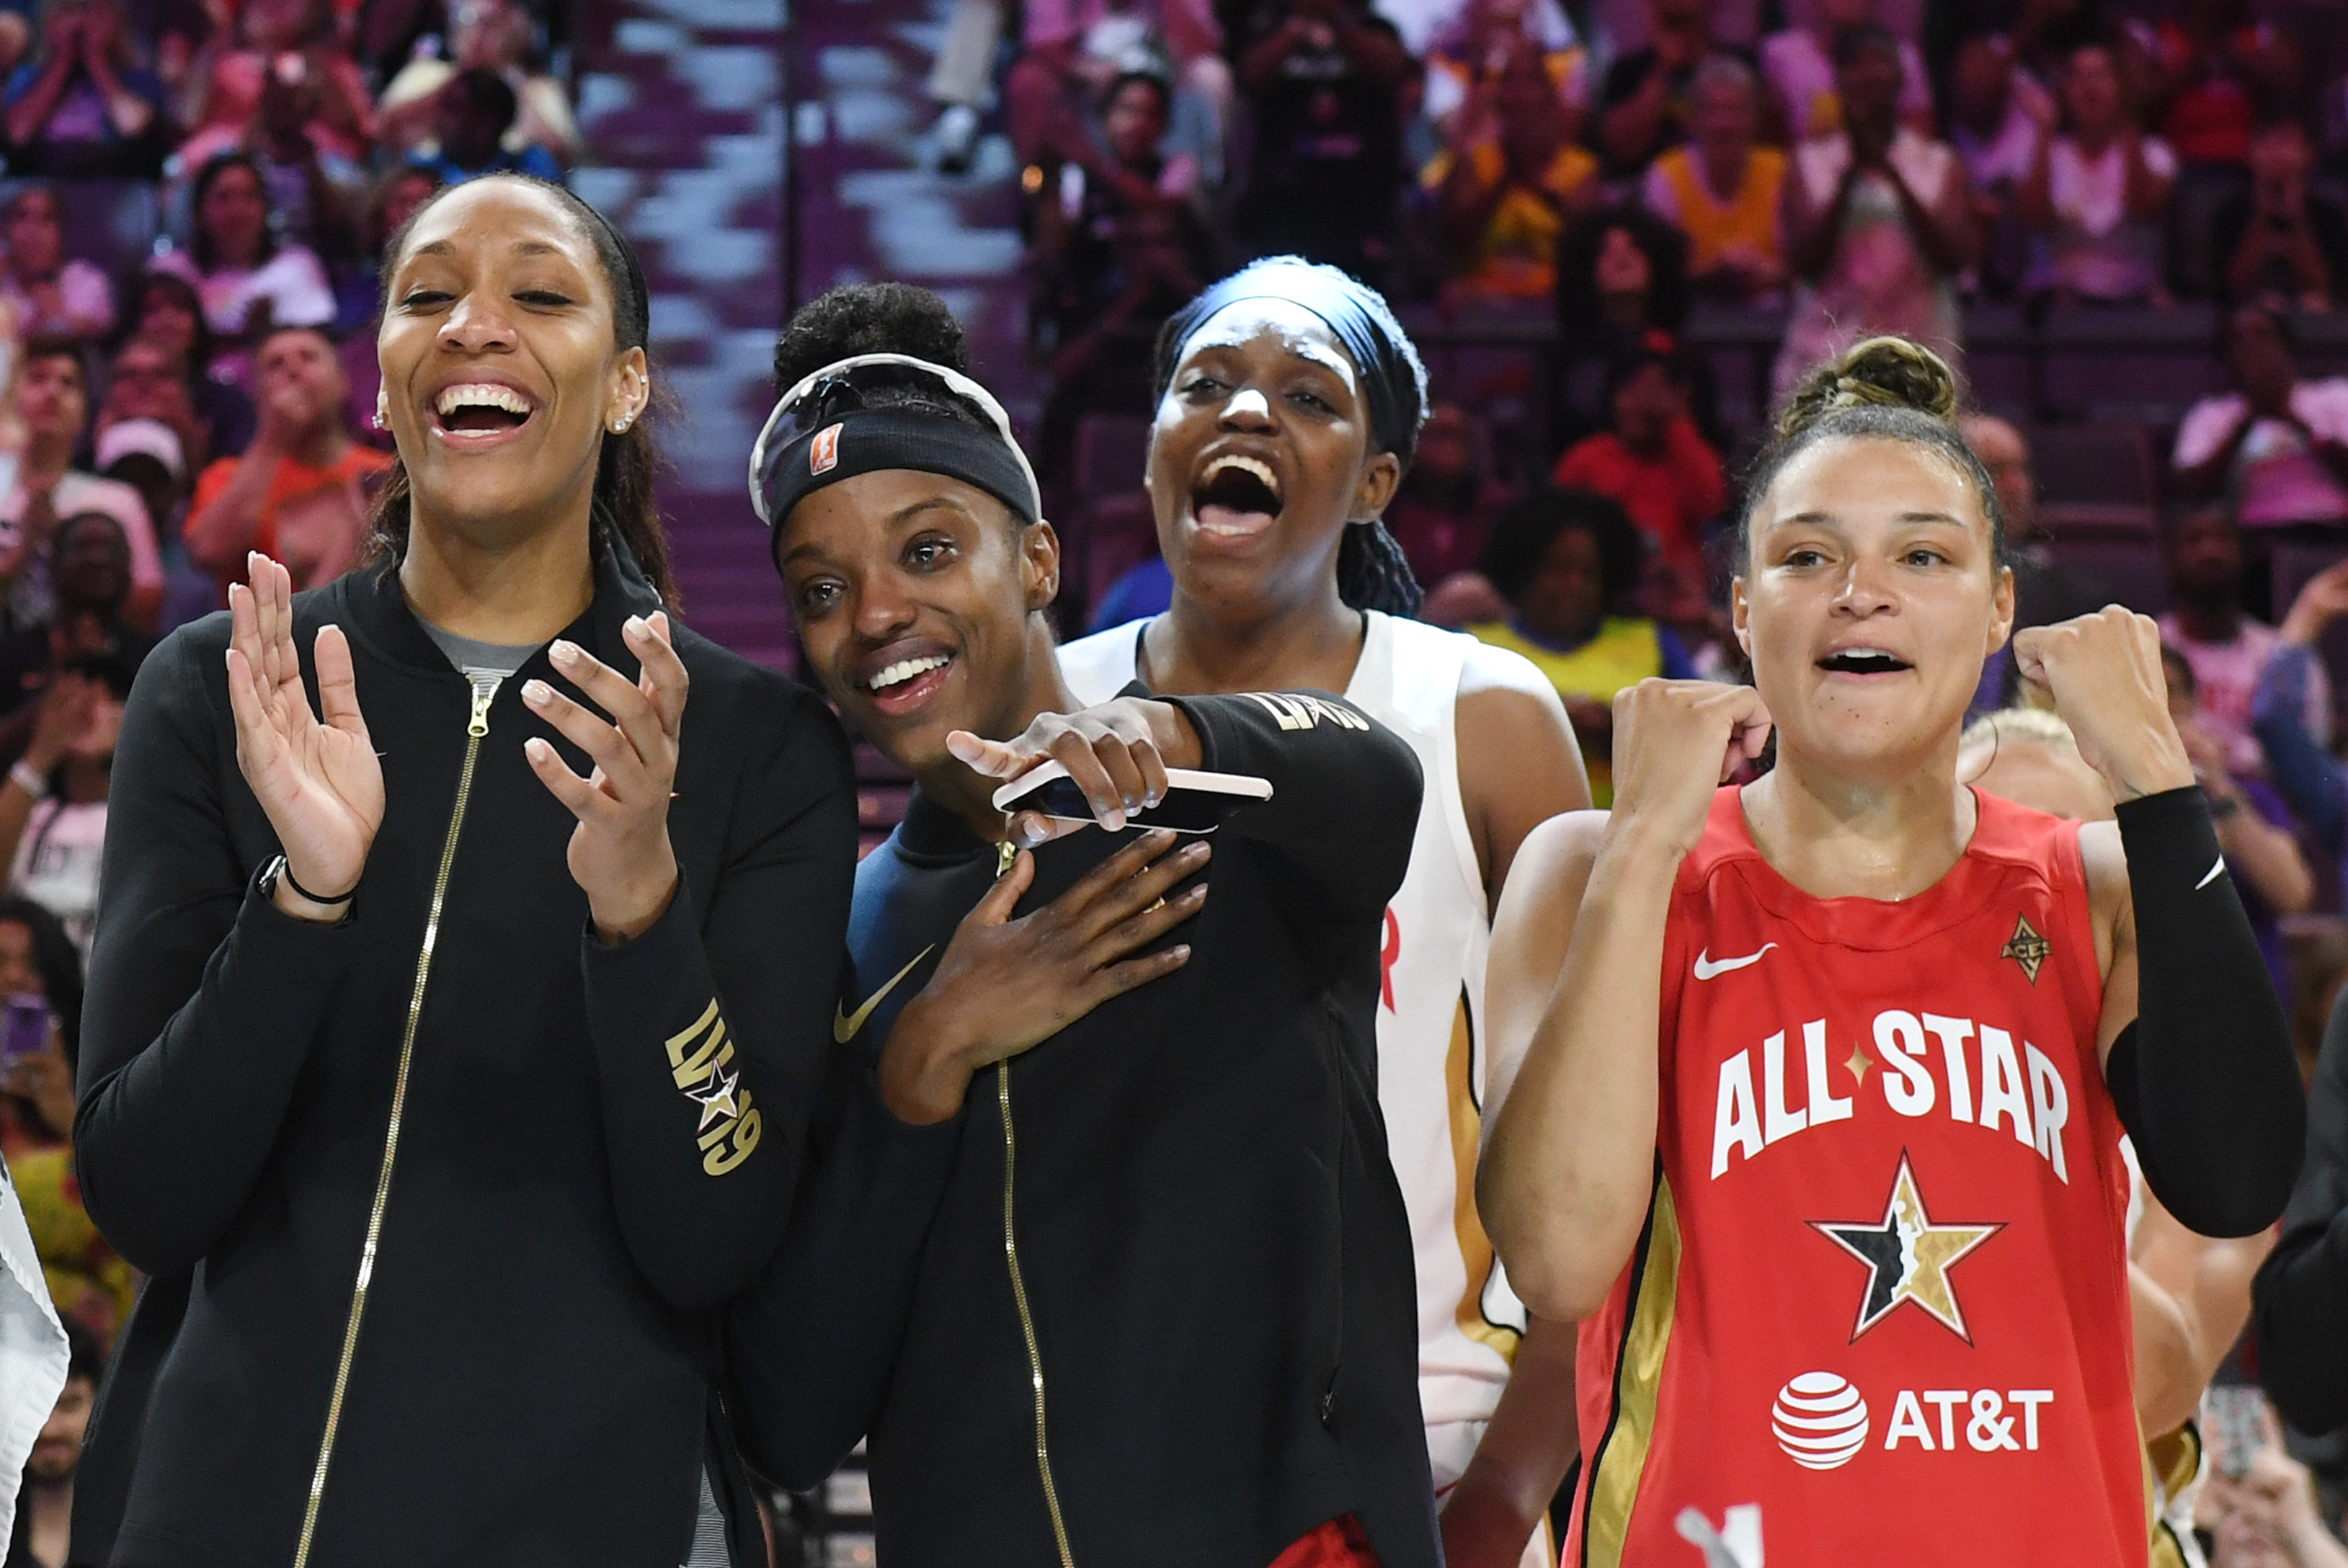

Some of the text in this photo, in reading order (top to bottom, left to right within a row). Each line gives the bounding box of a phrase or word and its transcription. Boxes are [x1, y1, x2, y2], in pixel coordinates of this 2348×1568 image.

[1711, 1010, 2069, 1185] ALL STAR
[1884, 1389, 2054, 1452] AT&T
